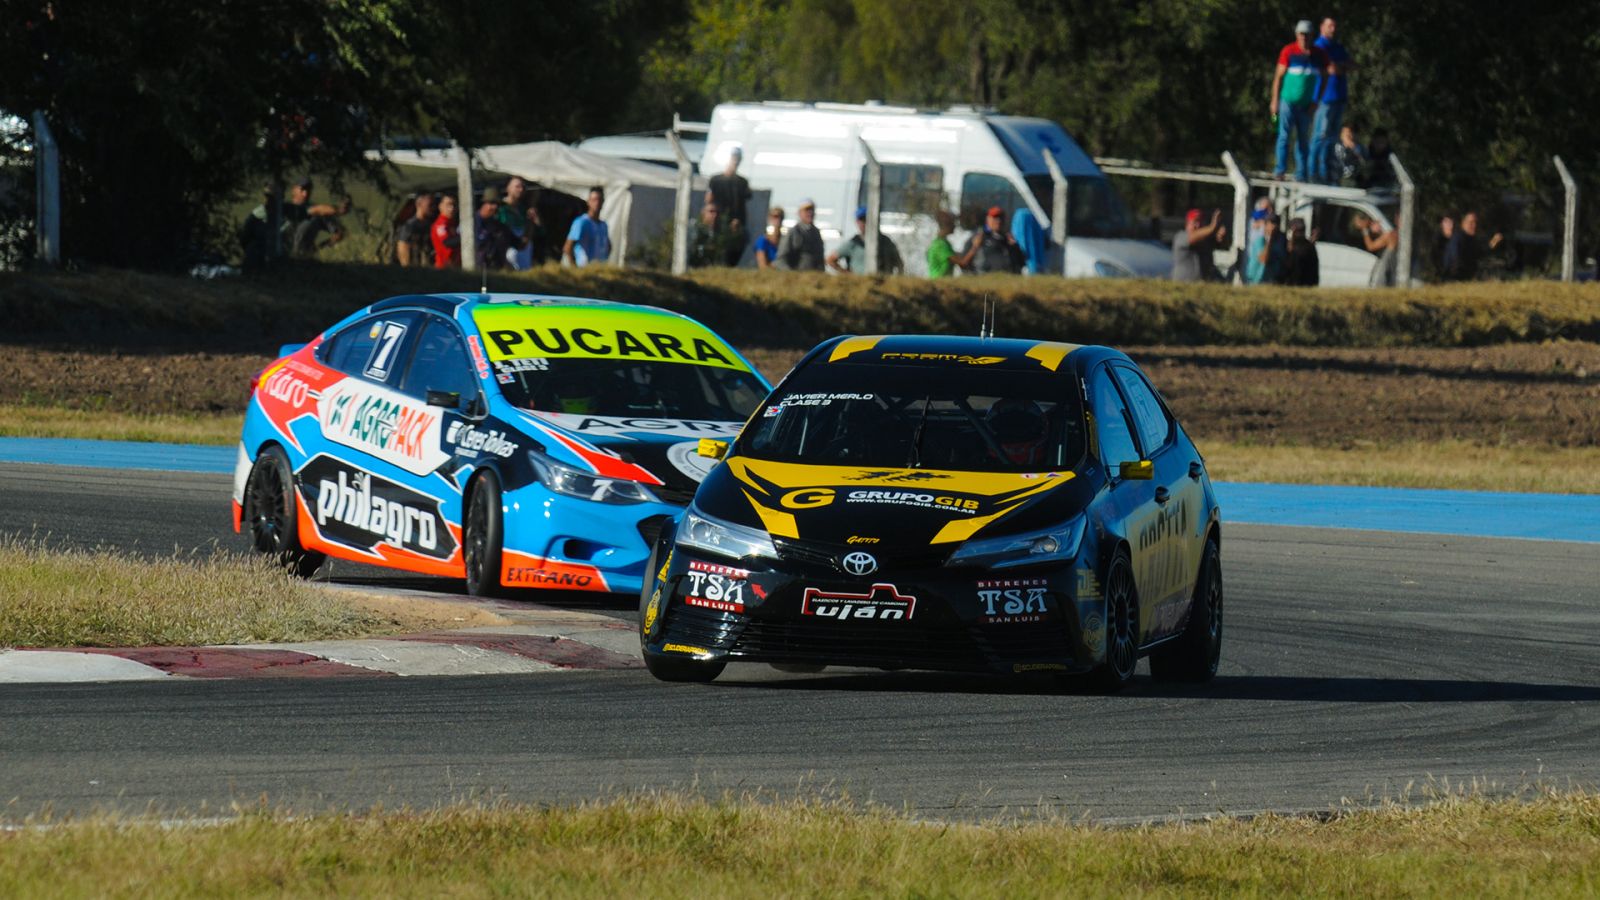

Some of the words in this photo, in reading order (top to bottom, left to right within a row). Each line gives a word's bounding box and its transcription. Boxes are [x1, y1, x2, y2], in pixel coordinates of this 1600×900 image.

[373, 324, 404, 369] 7
[487, 328, 735, 366] PUCARA
[780, 399, 821, 407] CLASE
[783, 393, 826, 401] JAVIER
[350, 394, 436, 460] AGROPACK
[590, 479, 614, 501] 7
[780, 487, 837, 509] G
[317, 470, 437, 550] philagro
[846, 498, 977, 515] WWW.GRUPOGIB.COM.AR
[689, 562, 749, 578] BITRENES
[688, 570, 747, 604] TSA
[977, 579, 1048, 588] BITRENES
[691, 599, 710, 608] SAN
[711, 601, 736, 612] LUIS
[977, 588, 1048, 615] TSA
[988, 616, 1011, 624] SAN
[1014, 615, 1040, 623] LUIS
